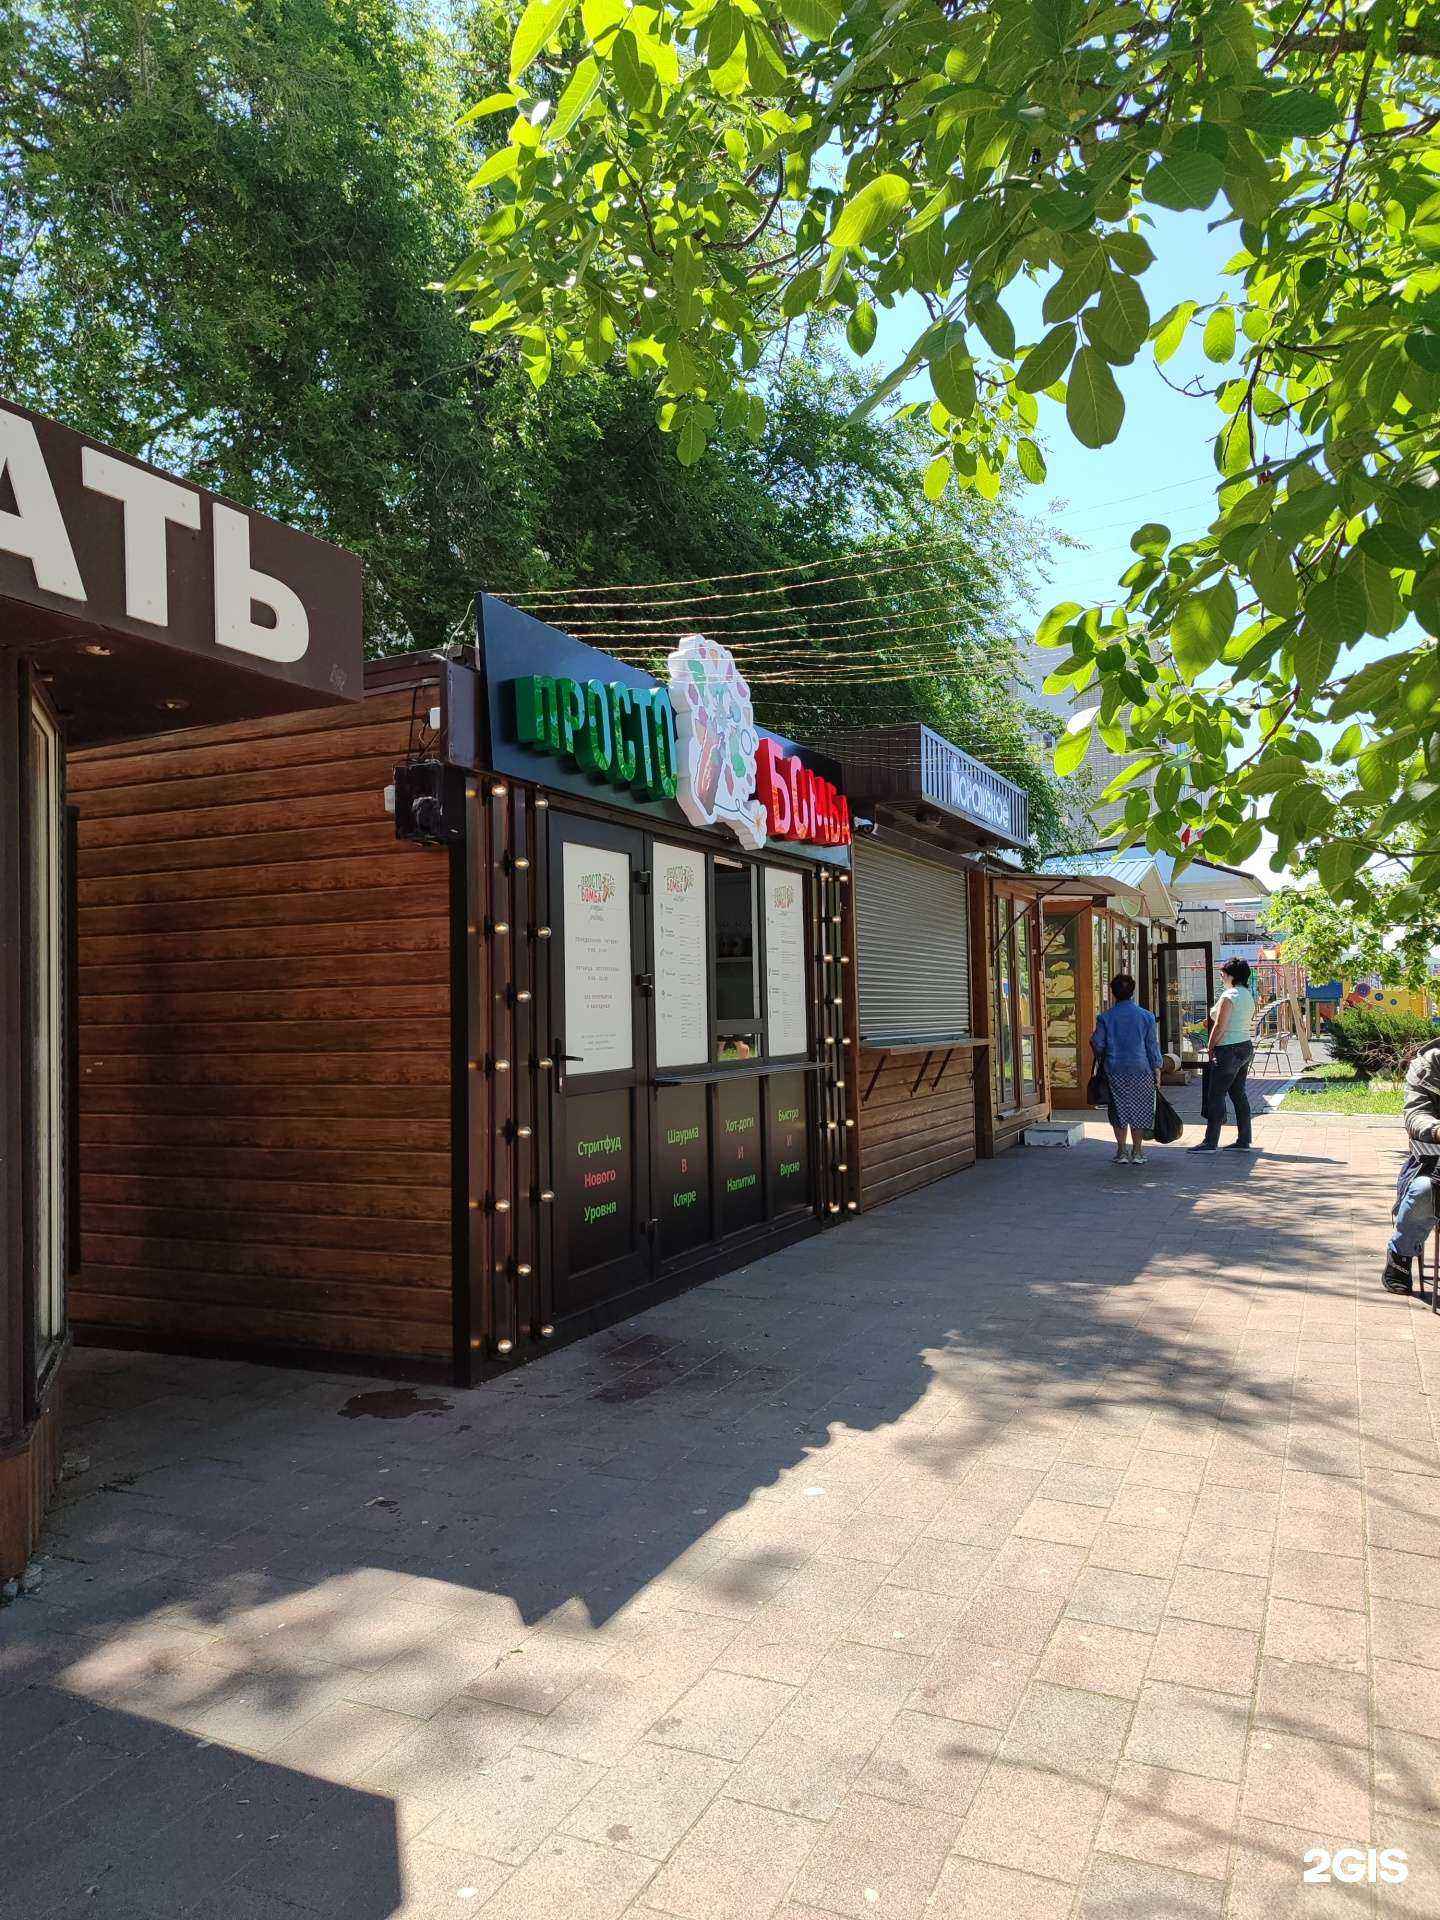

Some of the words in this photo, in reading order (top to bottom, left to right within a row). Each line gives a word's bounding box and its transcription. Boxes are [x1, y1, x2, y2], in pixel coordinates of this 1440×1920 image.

[531, 674, 678, 800] ПРОСТО
[764, 737, 851, 842] БОМБА
[778, 1108, 800, 1121] Быстро
[725, 1116, 754, 1133] Хот-доги
[667, 1126, 699, 1145] Шаурма
[577, 1135, 622, 1158] Стритфуд
[737, 1146, 744, 1159] И
[681, 1159, 688, 1173] В
[780, 1161, 800, 1178] Вкусно
[584, 1169, 616, 1188] Нового
[727, 1174, 756, 1192] Напитки
[673, 1190, 697, 1208] Кляре
[584, 1201, 617, 1223] Уровня
